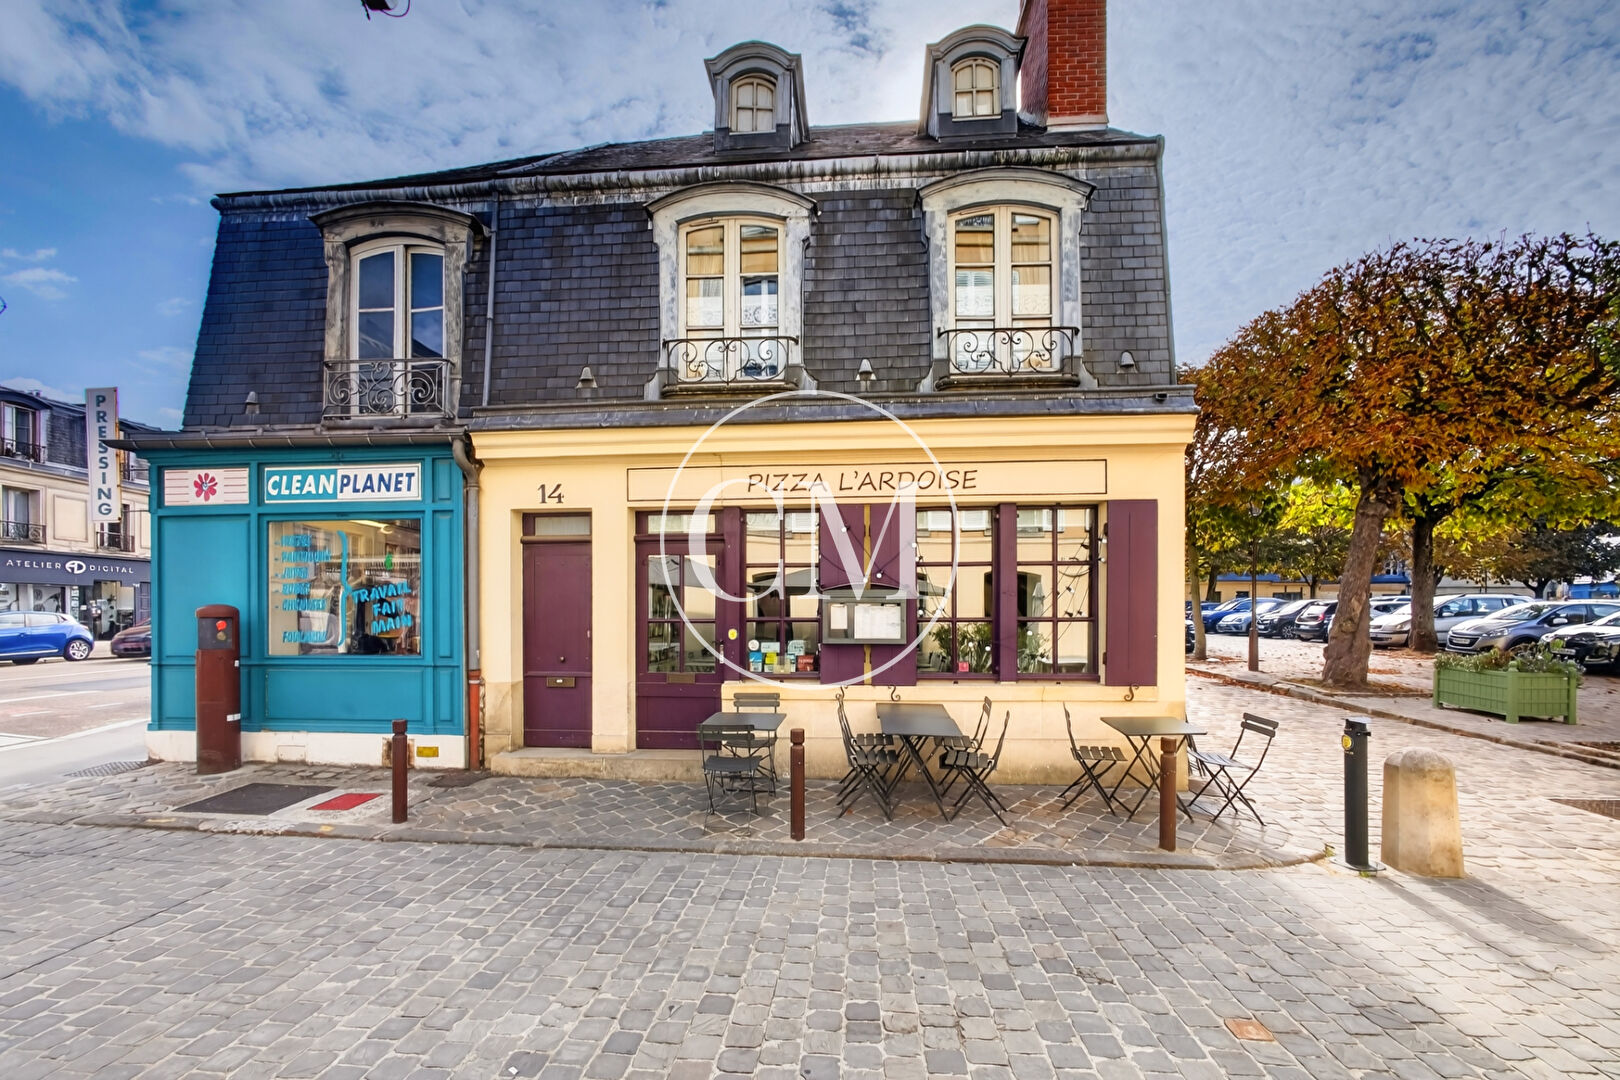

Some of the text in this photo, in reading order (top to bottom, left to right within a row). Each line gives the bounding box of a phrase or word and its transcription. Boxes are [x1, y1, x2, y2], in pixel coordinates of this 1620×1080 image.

[95, 395, 112, 516] PRESSING
[266, 472, 415, 496] CLEAN PLANET
[747, 470, 978, 492] PIZZA L'ARDOISE
[537, 483, 565, 504] 14
[6, 559, 61, 569] ATELIER
[90, 564, 134, 574] DIGITAL
[352, 579, 411, 604] TRAVAIL
[371, 614, 412, 635] MAIN
